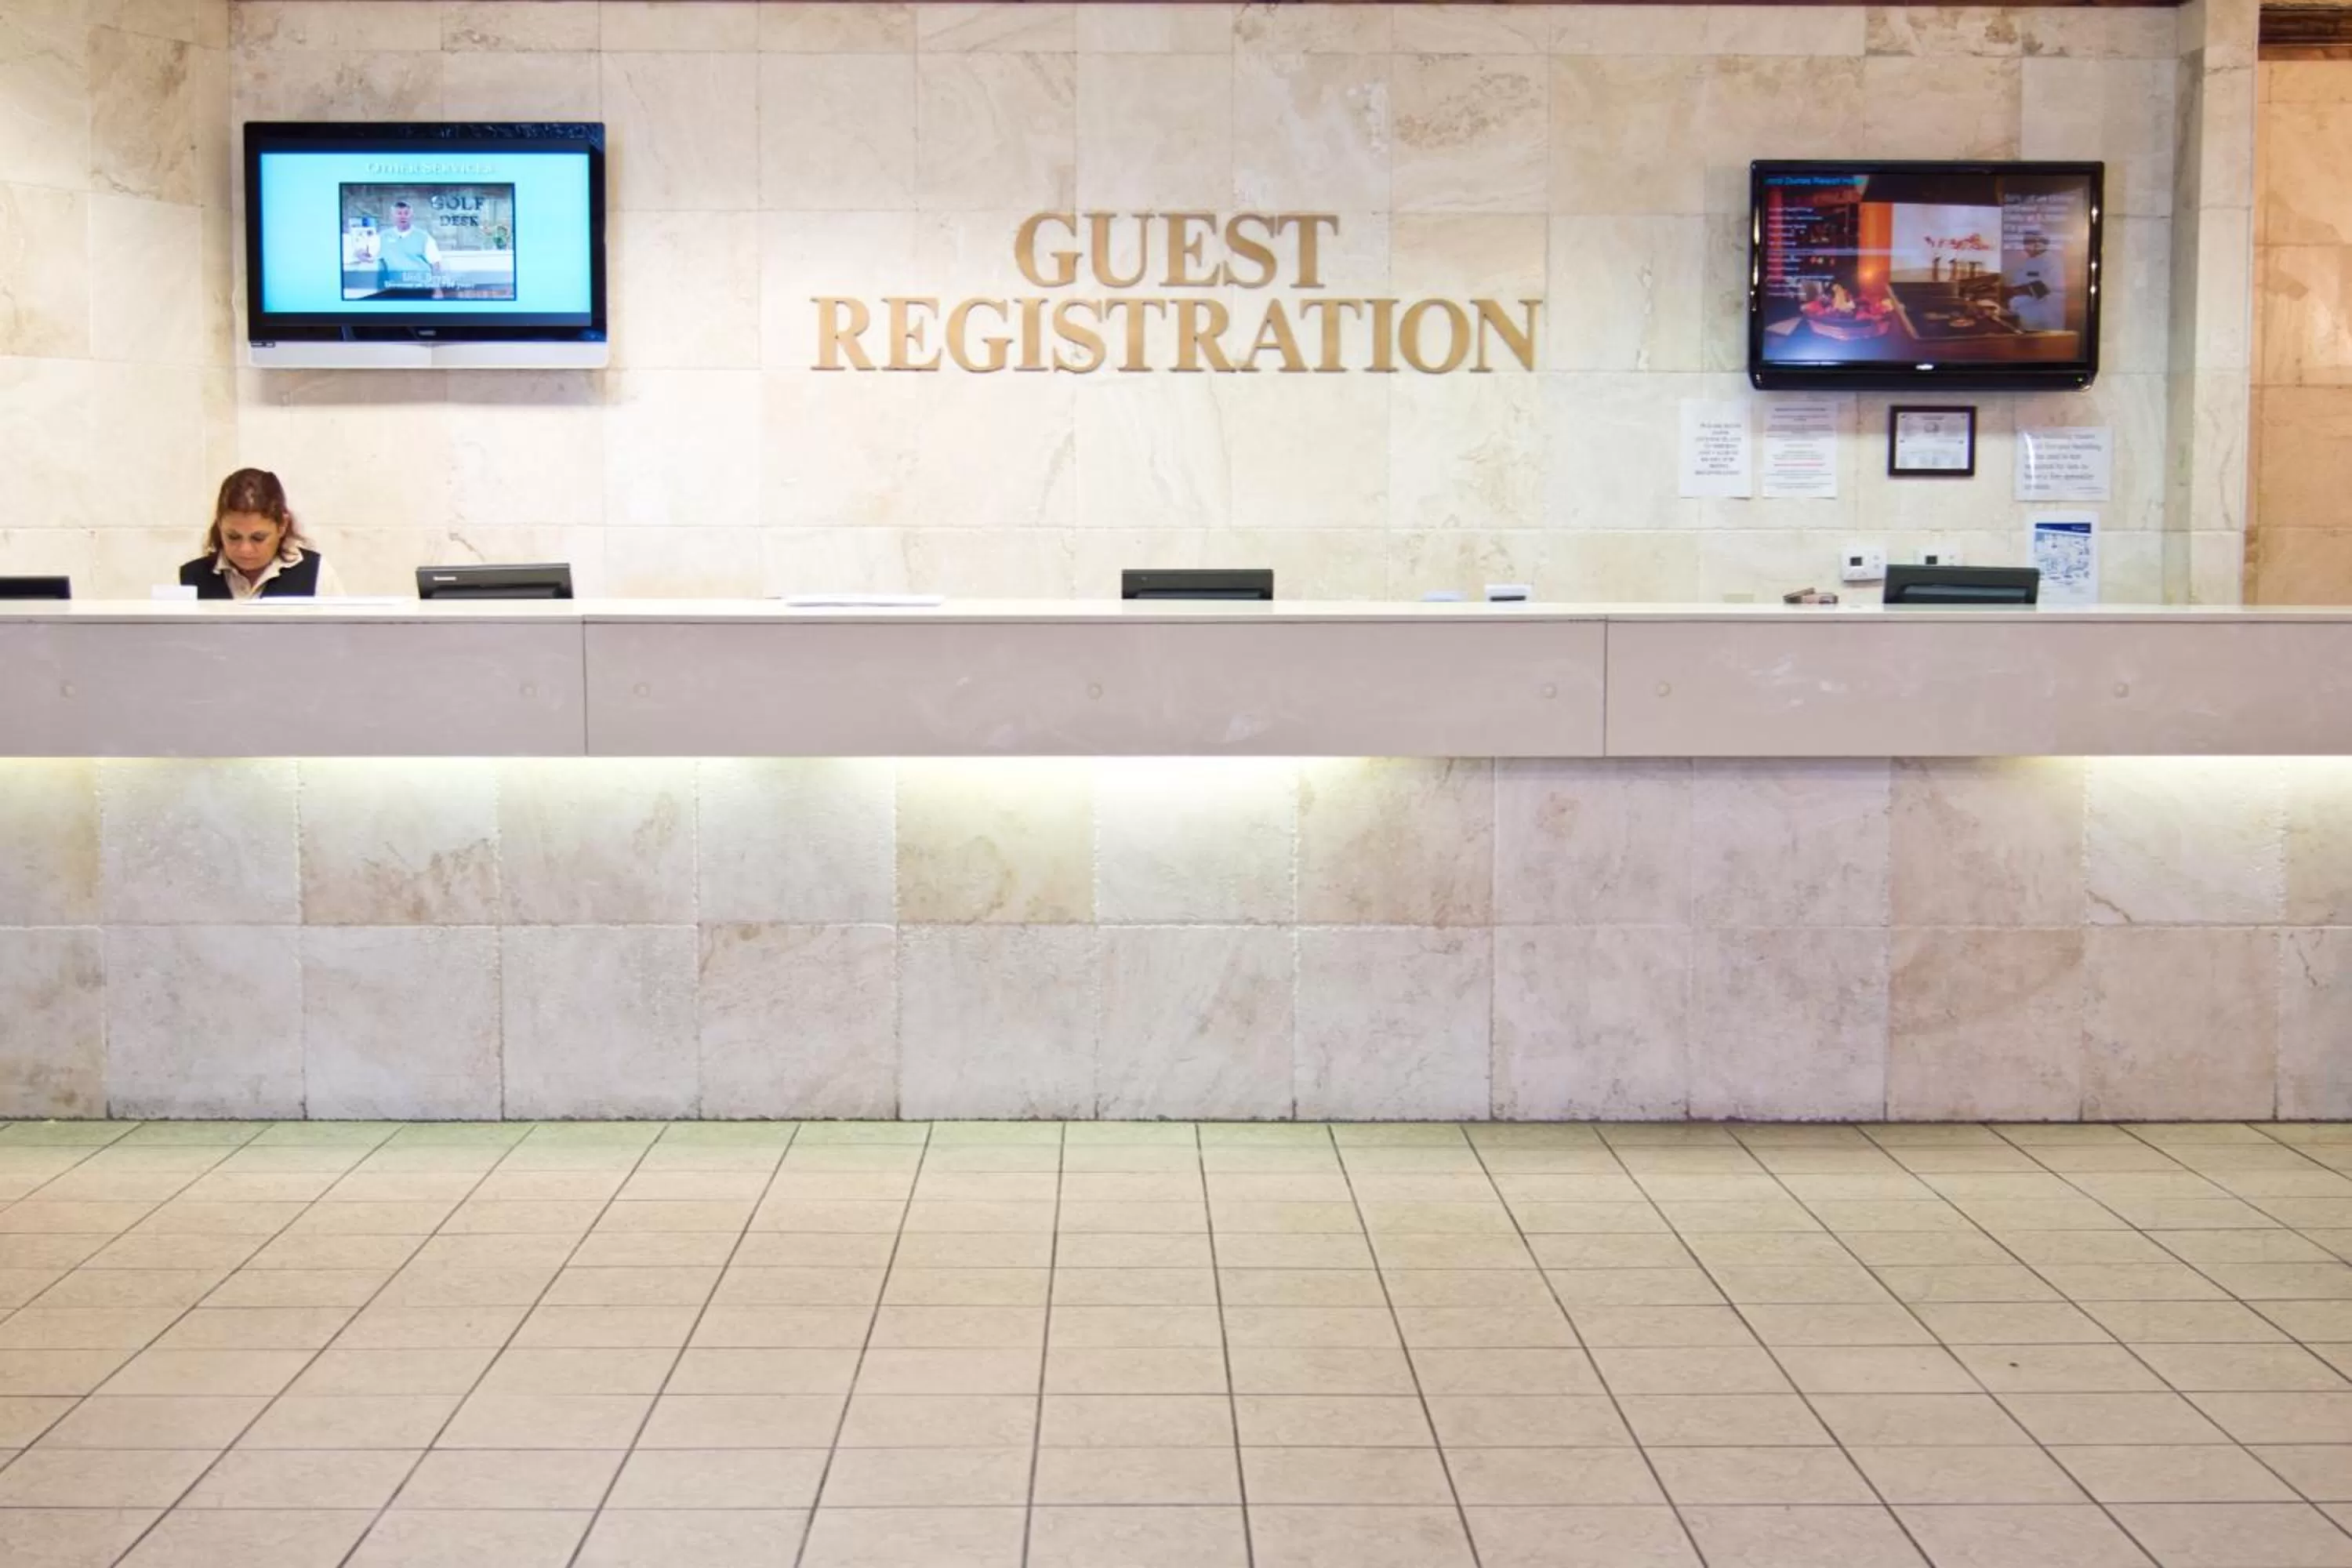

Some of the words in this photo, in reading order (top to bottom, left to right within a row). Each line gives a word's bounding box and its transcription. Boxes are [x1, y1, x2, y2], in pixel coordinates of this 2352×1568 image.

[430, 194, 485, 211] GOLF
[440, 216, 479, 227] DESK
[1013, 212, 1338, 289] GUEST
[810, 296, 1544, 373] REGISTRATION
